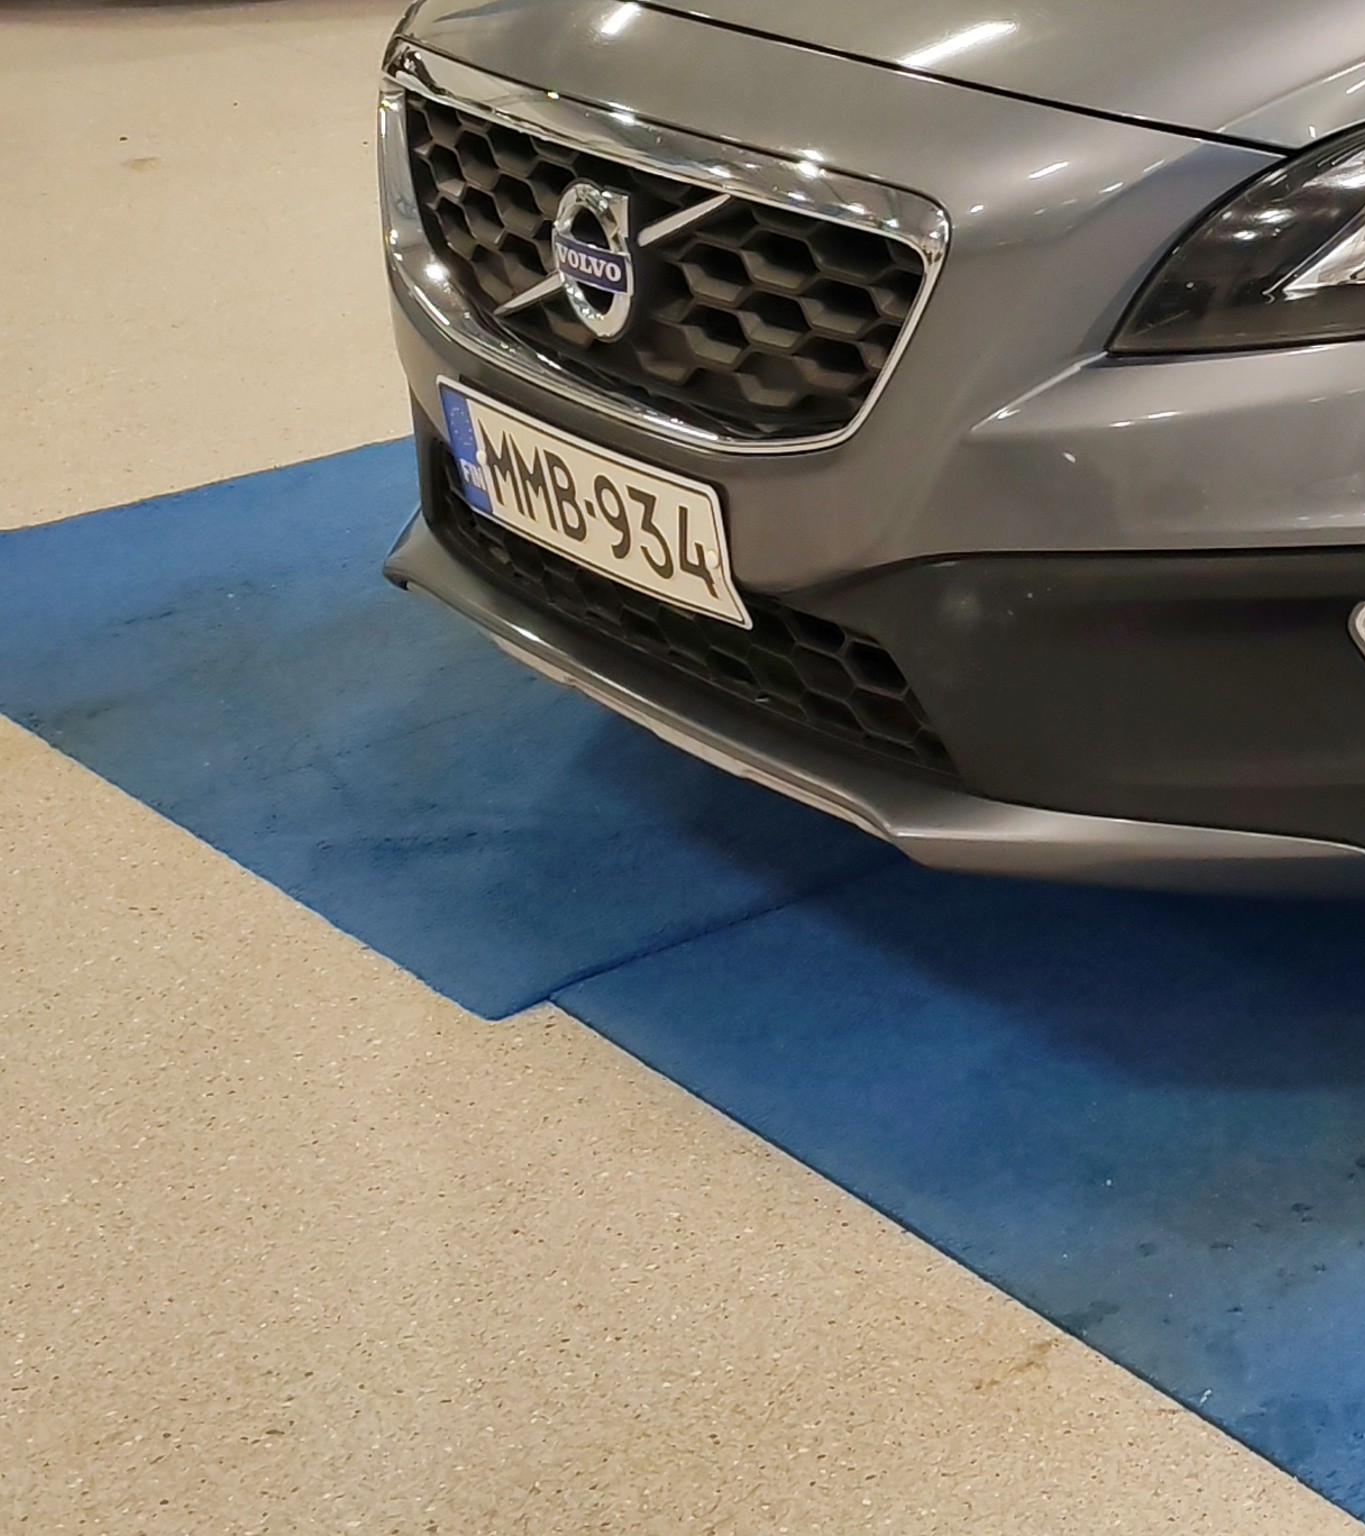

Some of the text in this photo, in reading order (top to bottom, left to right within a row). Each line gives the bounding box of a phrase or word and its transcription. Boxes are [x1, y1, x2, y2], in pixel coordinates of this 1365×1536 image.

[556, 242, 622, 282] VOLVO
[459, 457, 488, 491] FIN
[477, 417, 719, 600] MMB-934
